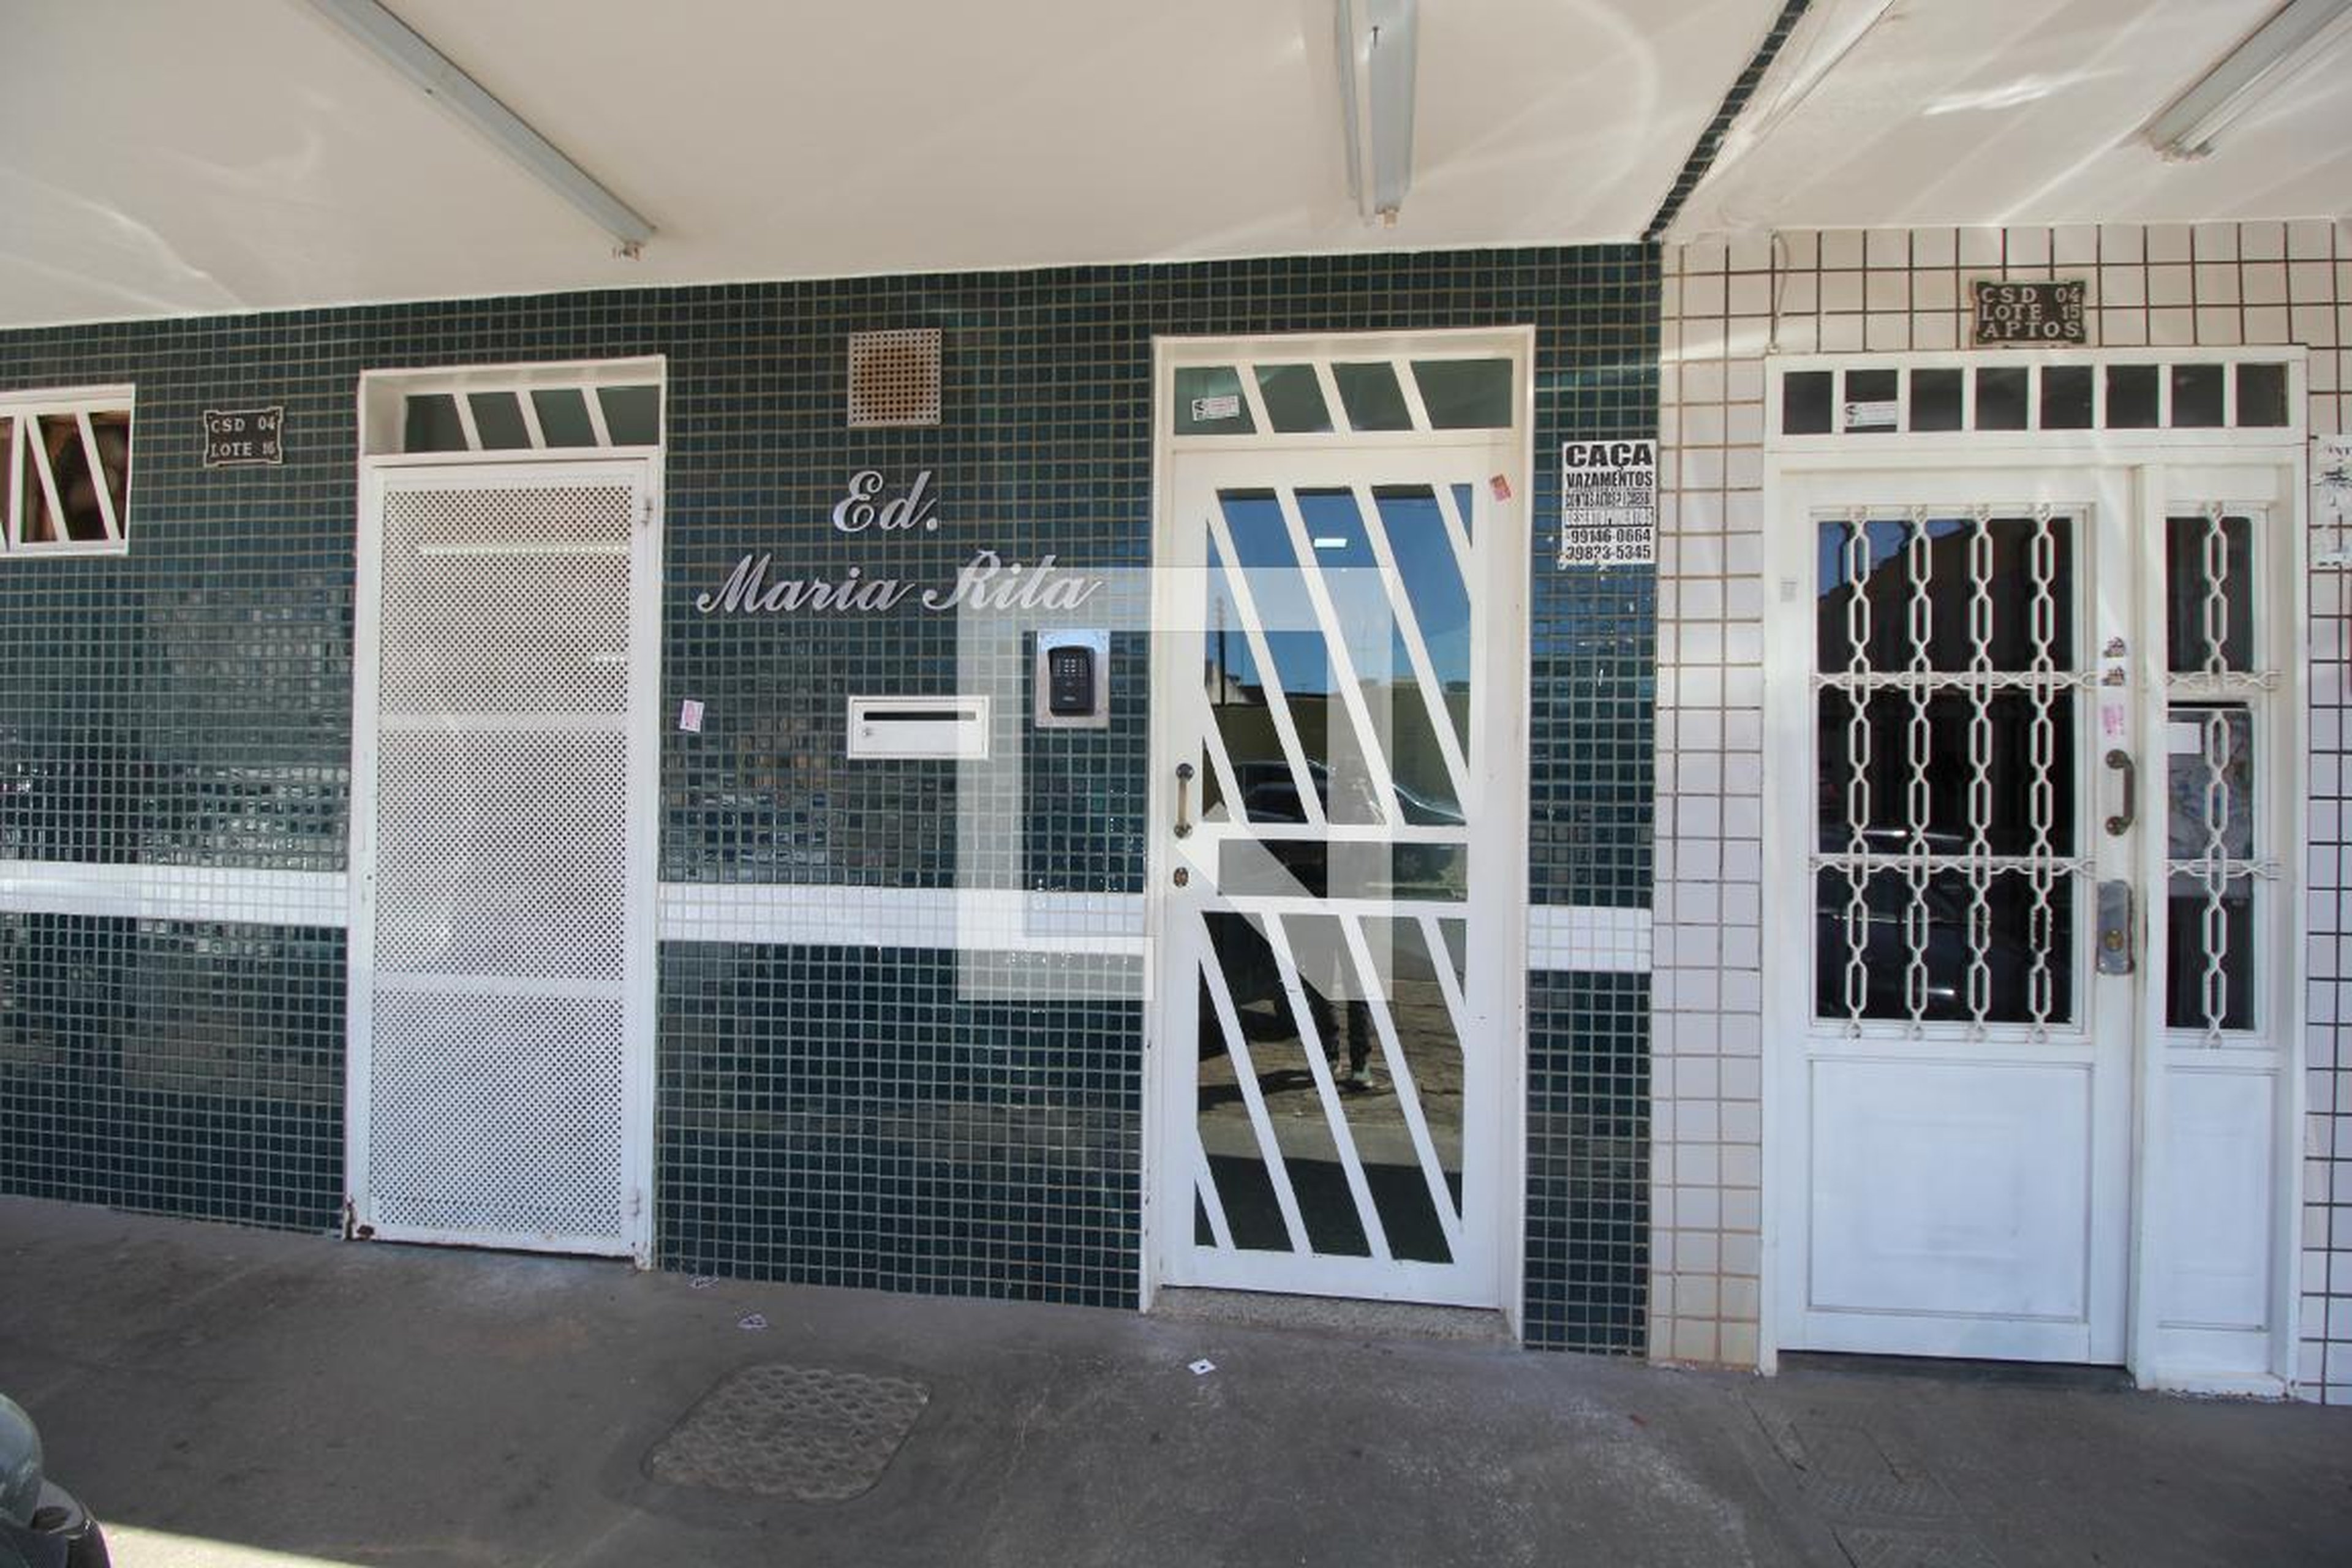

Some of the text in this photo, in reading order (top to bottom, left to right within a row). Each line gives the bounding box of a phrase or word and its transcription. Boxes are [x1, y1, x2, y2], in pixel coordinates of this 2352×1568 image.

[1981, 287, 2080, 303] CSD 04
[1982, 304, 2080, 321] LOTE 15
[1983, 321, 2081, 337] APTOS
[211, 415, 276, 433] CSD 04
[211, 442, 252, 458] LOTE
[1566, 443, 1653, 470] CAÇA
[1566, 470, 1653, 488] VAZAMENTOS
[832, 470, 938, 532] Ed.
[696, 549, 1103, 613] Maria Rita
